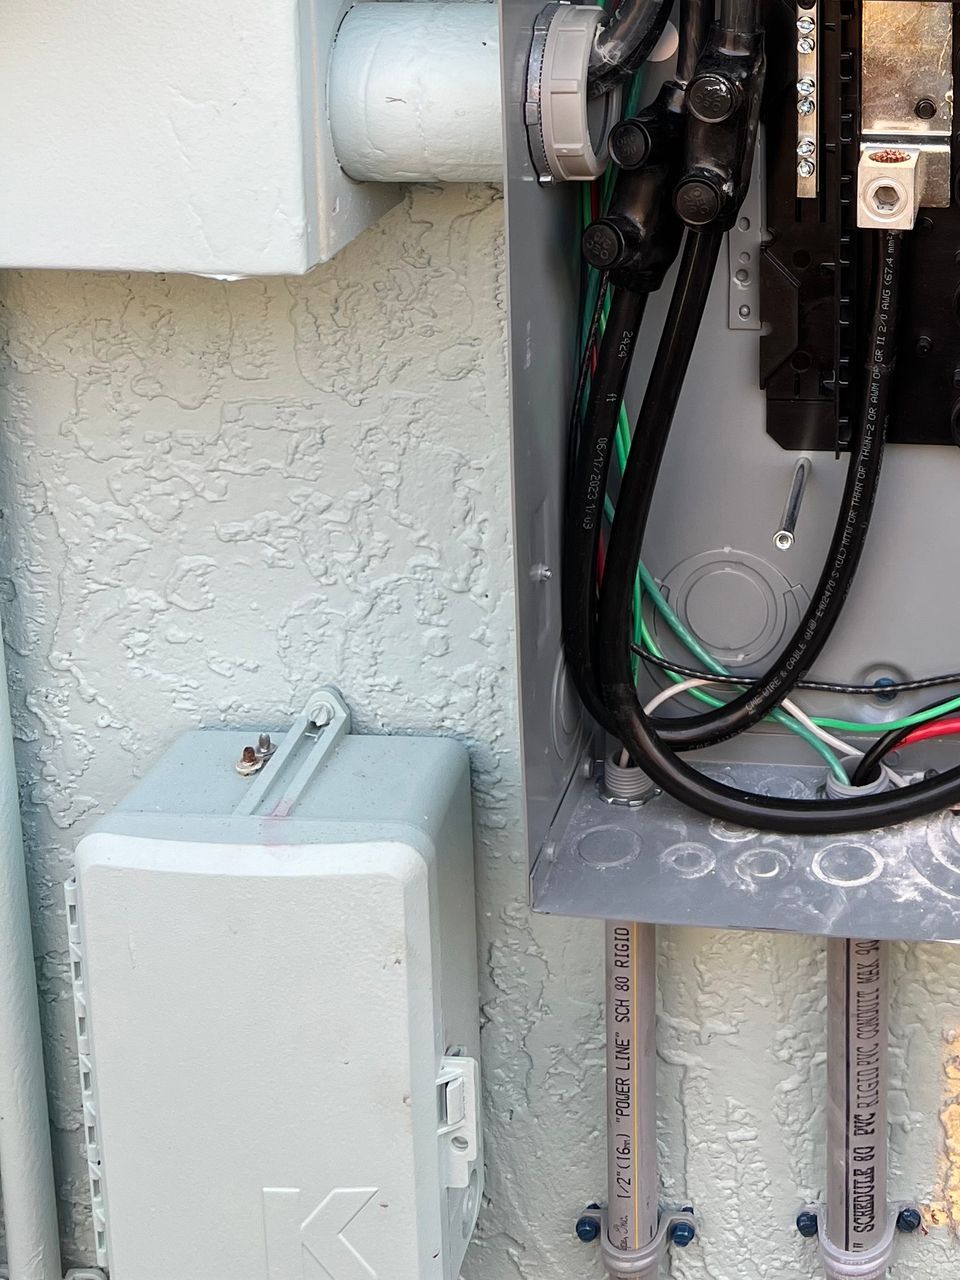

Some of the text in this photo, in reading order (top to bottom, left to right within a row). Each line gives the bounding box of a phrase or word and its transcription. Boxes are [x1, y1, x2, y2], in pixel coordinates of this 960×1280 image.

[881, 289, 891, 310] AWG
[878, 313, 888, 333] 2/0
[875, 349, 884, 363] GR
[870, 383, 880, 404] AWM
[867, 407, 877, 420] OR
[861, 424, 875, 460] THWN-2
[587, 437, 608, 500] 06/17/2023
[856, 465, 866, 479] OR
[851, 482, 865, 507] THHN
[847, 510, 857, 523] OR
[841, 527, 853, 545] MTW
[815, 580, 836, 618] E102470
[785, 642, 807, 670] CABLE
[762, 676, 783, 697] WIRE
[613, 927, 630, 969] RIGID
[614, 976, 629, 992] 80
[614, 999, 630, 1023] SCH
[856, 991, 880, 1040] CONDUIT
[614, 1031, 630, 1071] LINE"
[856, 1042, 880, 1066] PVC
[614, 1074, 630, 1124] "POWER
[856, 1066, 880, 1109] RIGID
[853, 1112, 876, 1137] PVC
[853, 1146, 875, 1163] 80
[852, 1166, 876, 1234] SCHEDULE
